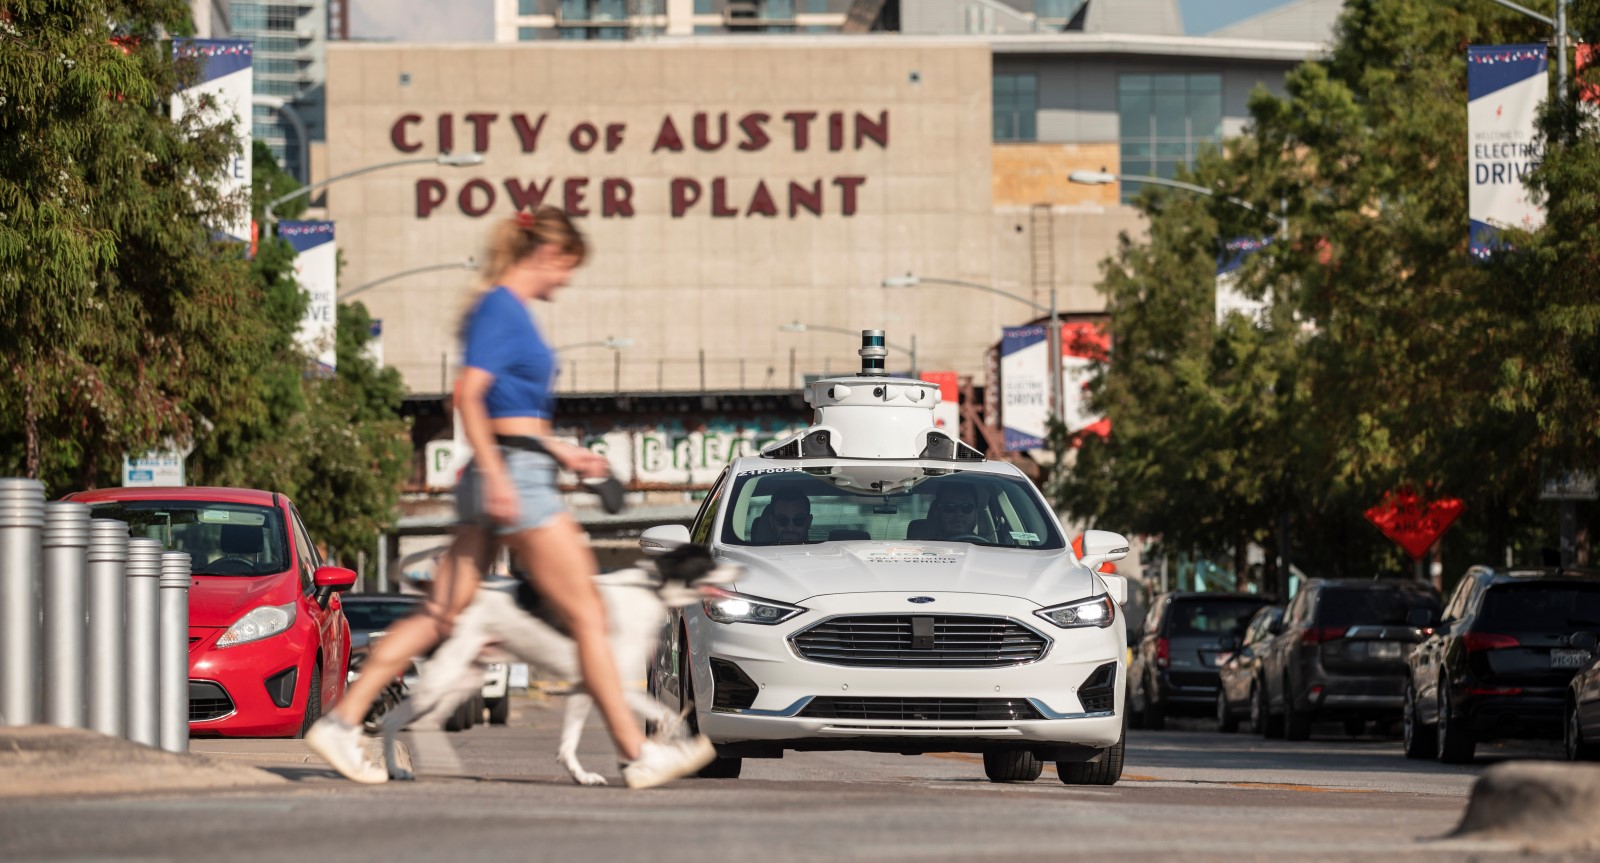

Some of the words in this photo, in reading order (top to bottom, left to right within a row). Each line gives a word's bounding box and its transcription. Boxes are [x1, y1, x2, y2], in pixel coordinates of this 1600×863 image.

[391, 112, 548, 154] CITY
[568, 121, 627, 153] OF
[652, 109, 889, 154] AUSTIN
[415, 177, 635, 218] POWER
[670, 176, 867, 218] PLANT
